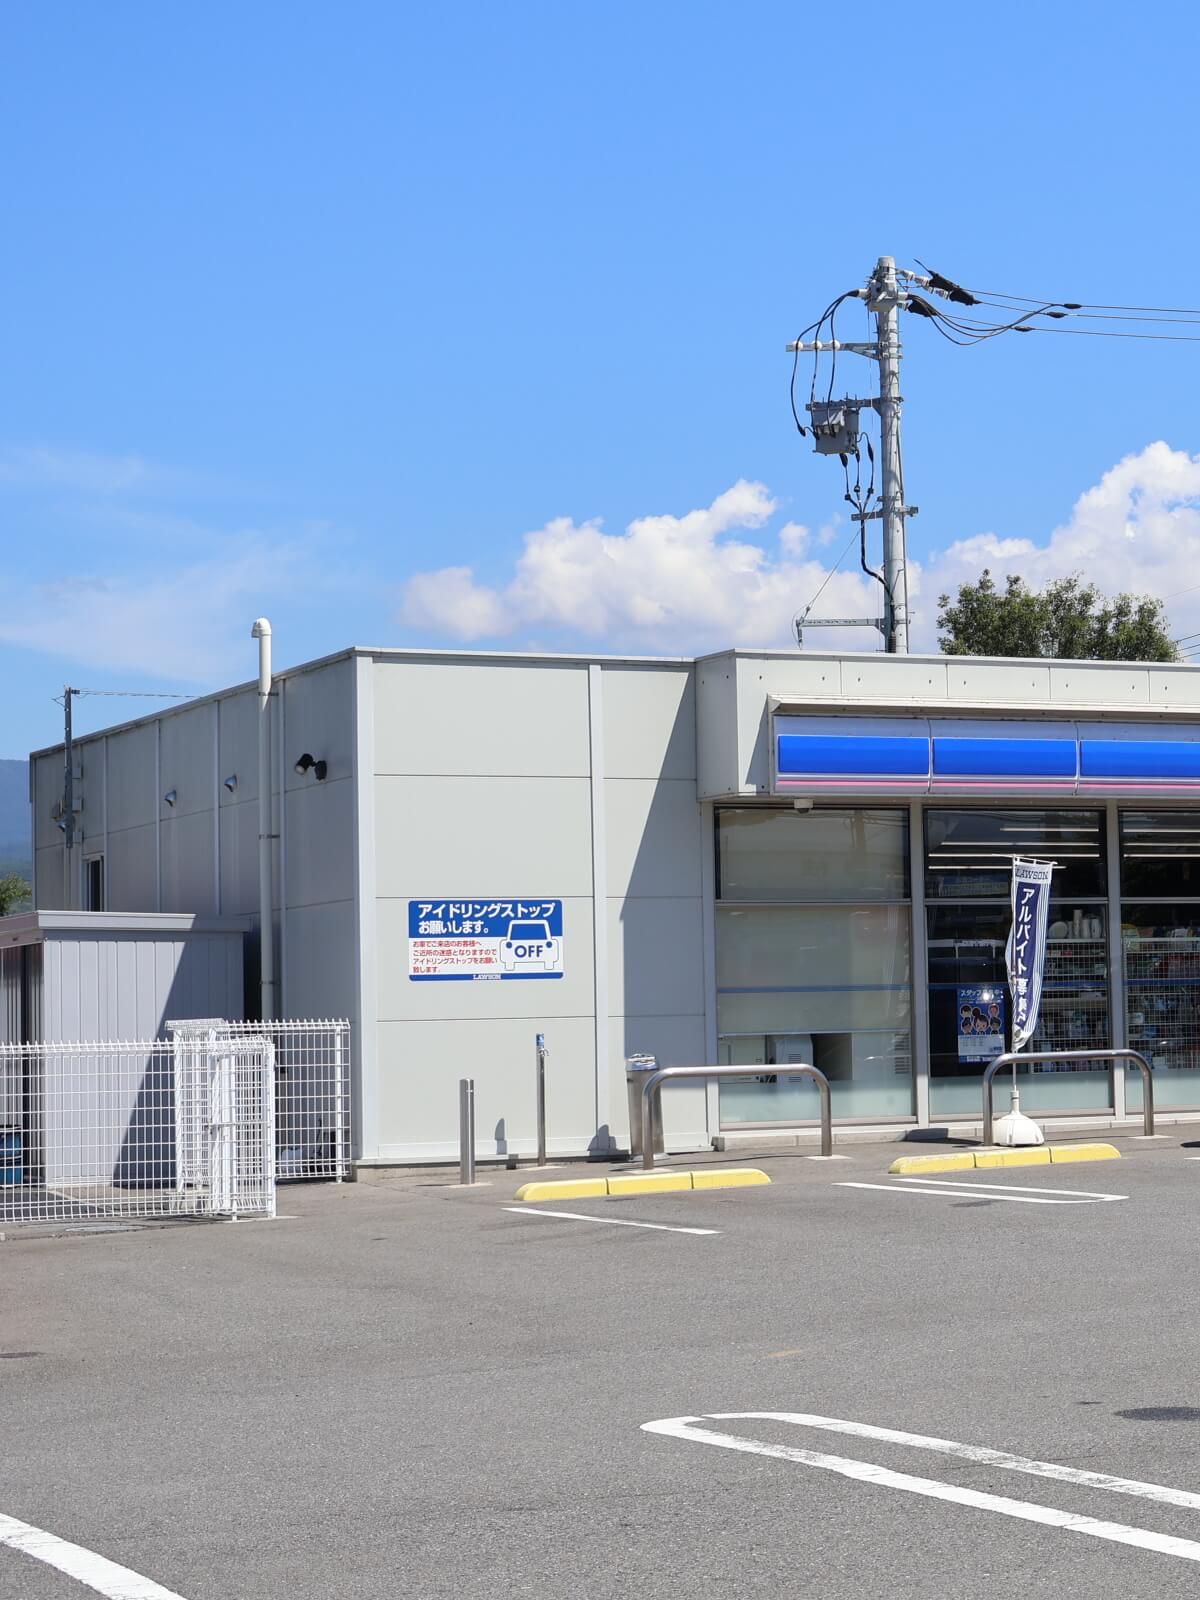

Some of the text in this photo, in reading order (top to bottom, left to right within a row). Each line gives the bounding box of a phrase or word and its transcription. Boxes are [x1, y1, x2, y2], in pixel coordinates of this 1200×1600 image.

[1016, 867, 1049, 880] LAWSON
[418, 903, 555, 918] アイドリングストップ
[418, 920, 489, 935] お願いします。
[514, 945, 543, 958] OFF
